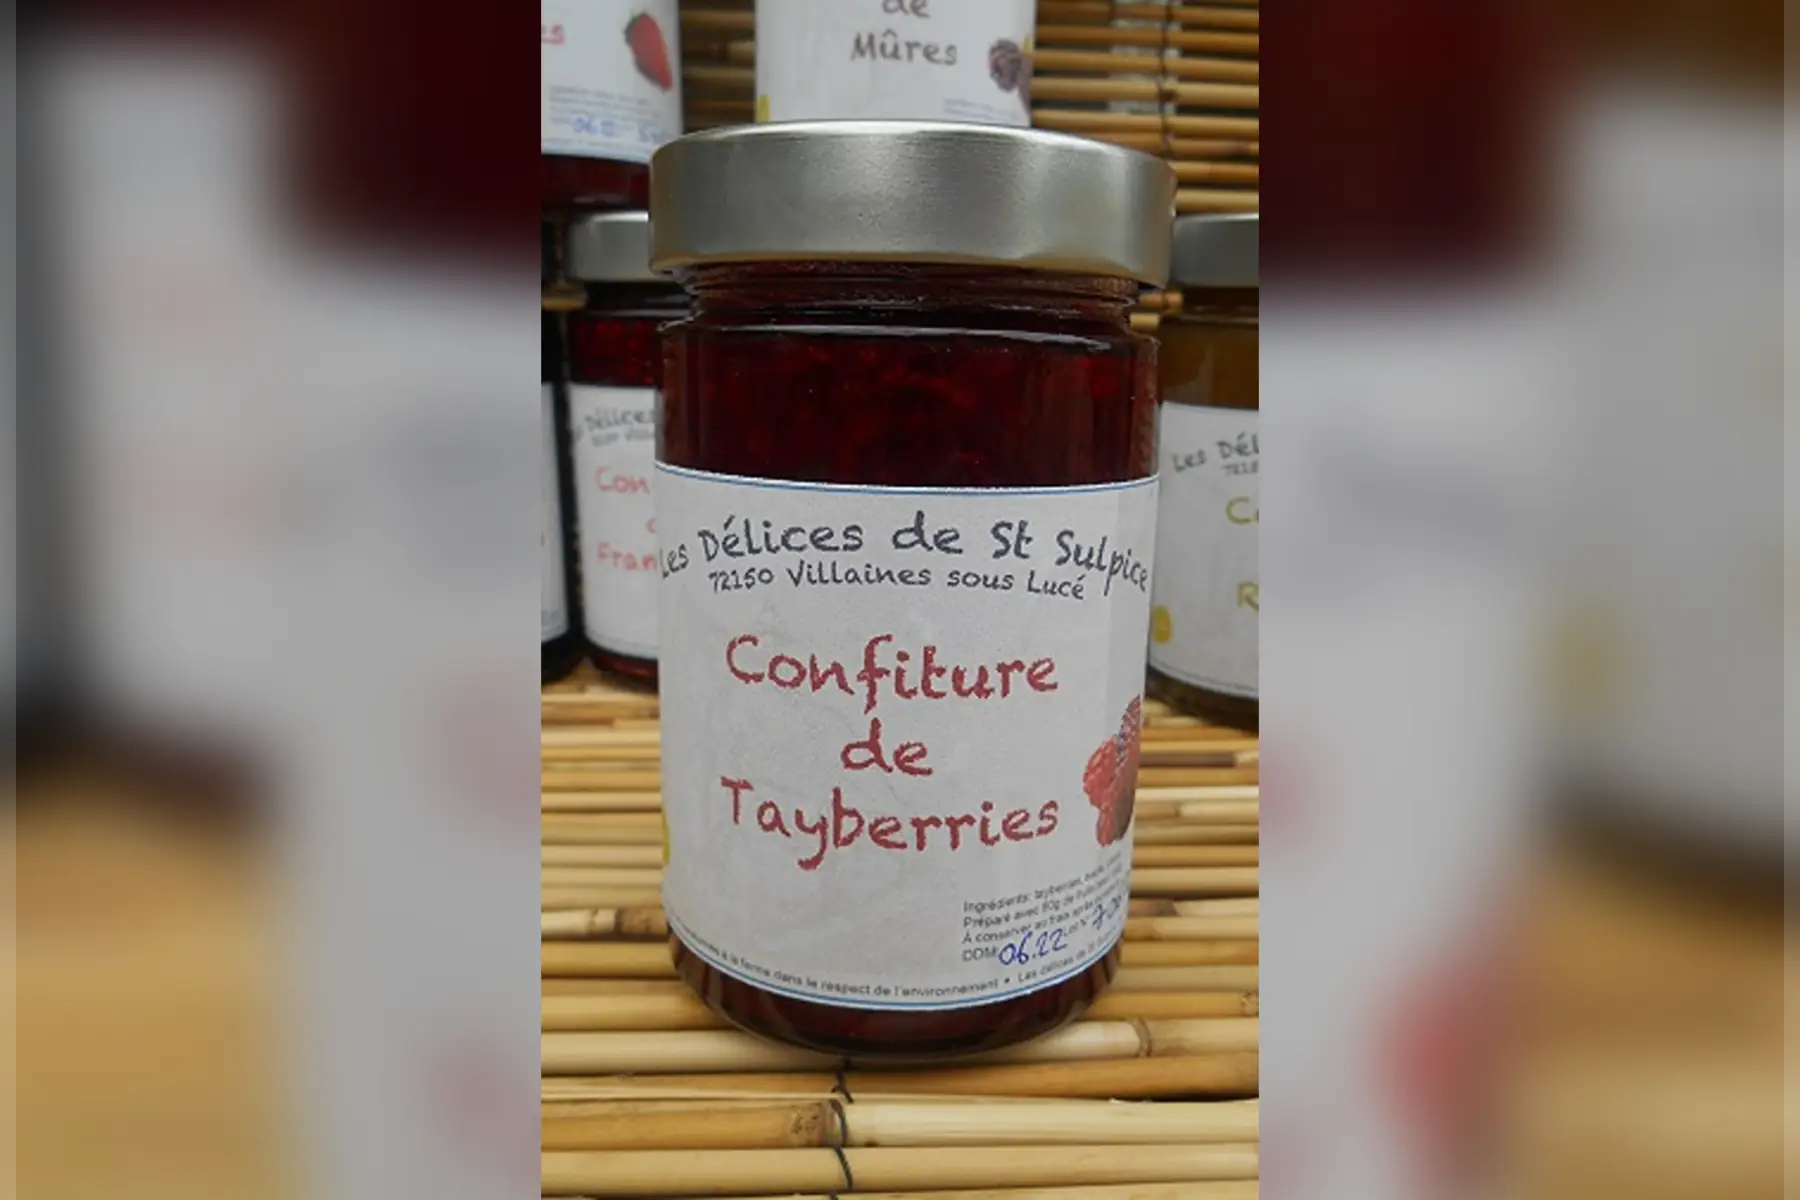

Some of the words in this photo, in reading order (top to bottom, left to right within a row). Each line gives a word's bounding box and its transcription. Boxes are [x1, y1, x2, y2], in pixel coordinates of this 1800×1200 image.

[850, 28, 958, 66] Mûres
[1226, 496, 1259, 526] C
[660, 543, 690, 579] Les
[698, 514, 864, 562] Délices
[892, 510, 963, 555] de
[989, 519, 1033, 559] St
[1054, 529, 1149, 597] Sulpice
[707, 566, 775, 594] 72150
[785, 560, 932, 588] Villaines
[946, 569, 1014, 591] sous
[1027, 569, 1086, 600] Lucé
[725, 632, 1059, 715] Confiture
[840, 717, 933, 776] de
[720, 774, 1059, 871] Tayberries
[820, 980, 870, 995] respect
[873, 985, 891, 997] de
